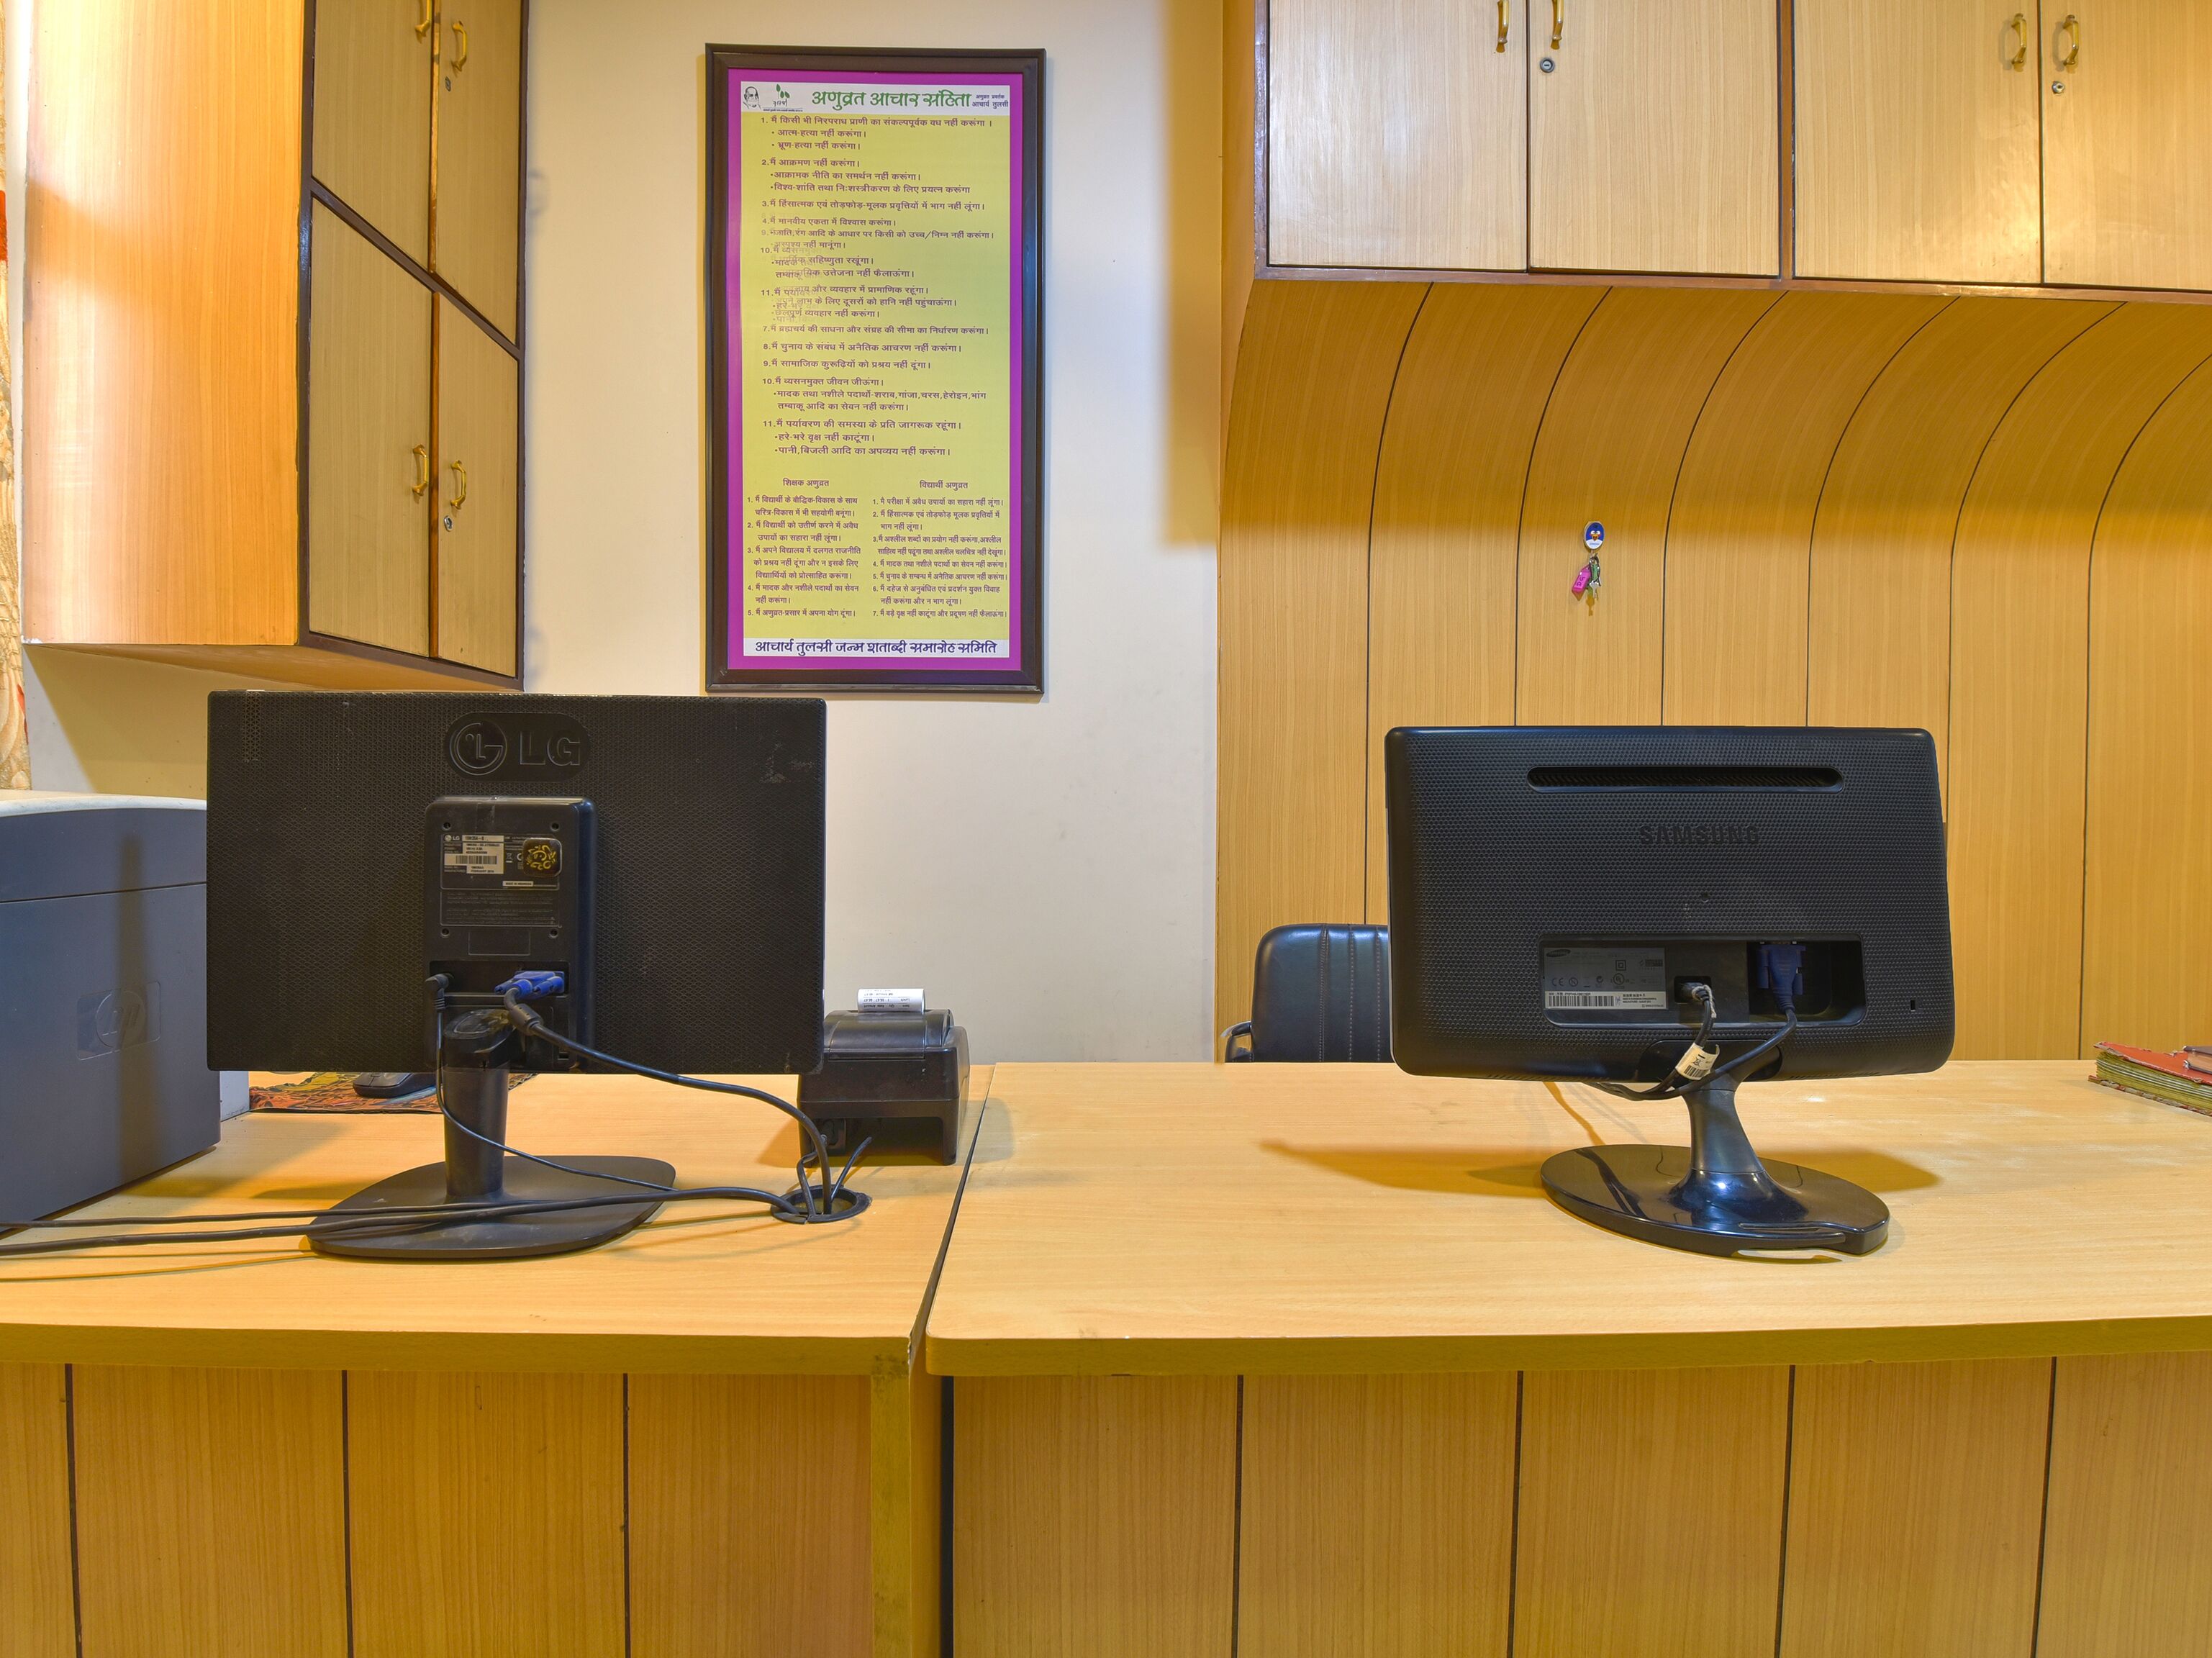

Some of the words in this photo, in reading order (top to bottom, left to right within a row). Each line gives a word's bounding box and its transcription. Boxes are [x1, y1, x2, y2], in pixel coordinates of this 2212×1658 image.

[811, 90, 867, 112] अणुव्रत
[869, 91, 921, 107] आचार
[992, 99, 1008, 109] तुलसी
[779, 114, 800, 124] किसी
[802, 114, 812, 124] भी
[814, 115, 848, 124] निरपराध
[848, 116, 868, 125] प्राणी
[882, 116, 928, 127] संकल्पपूर्वक
[943, 117, 958, 127] नहीं
[960, 117, 985, 127] करूंगा
[820, 127, 835, 138] नहीं
[813, 140, 829, 150] नहीं
[812, 157, 828, 167] नहीं
[811, 170, 830, 178] नीति
[844, 170, 872, 180] समर्थन
[874, 171, 889, 181] नहीं
[892, 184, 901, 192] के
[902, 184, 919, 194] लिए
[944, 184, 970, 194] करूंगा
[778, 198, 814, 208] हिंसात्मक
[816, 199, 828, 209] एवं
[889, 199, 919, 212] प्रवृत्तियों
[946, 201, 961, 210] नहीं
[777, 215, 806, 225] मानवीय
[839, 217, 866, 226] विश्वास
[780, 343, 803, 352] चुनाव
[804, 341, 814, 350] के
[815, 341, 836, 350] संबंध
[847, 342, 879, 351] अनैतिक
[913, 342, 929, 353] नहीं
[780, 358, 819, 367] सामाजिक
[857, 359, 869, 368] को
[892, 358, 907, 369] नहीं
[783, 378, 825, 387] व्यसनमुक्त
[825, 376, 849, 385] जीवन
[776, 402, 805, 412] तम्बाकू
[805, 401, 825, 409] आदि
[840, 401, 860, 410] सेवन
[861, 401, 877, 411] नहीं
[785, 417, 820, 427] पर्यावरण
[822, 418, 835, 427] की
[868, 419, 877, 428] के
[879, 419, 896, 428] प्रति
[807, 433, 822, 443] वृक्ष
[823, 431, 840, 442] नहीं
[830, 445, 852, 455] आदि
[900, 445, 916, 456] नहीं
[782, 477, 804, 486] शिक्षक
[805, 479, 829, 489] अणुव्रत
[919, 479, 943, 489] विद्यार्थी
[945, 481, 968, 491] अणुव्रत
[755, 638, 794, 652] आचार्य
[796, 638, 833, 656] तुलसी
[835, 642, 864, 652] जन्म
[866, 639, 907, 654] शताब्दी
[910, 640, 955, 653] समारोह
[957, 639, 997, 653] समिति
[519, 730, 581, 766] LG
[1639, 824, 1759, 843] SAMSUNG
